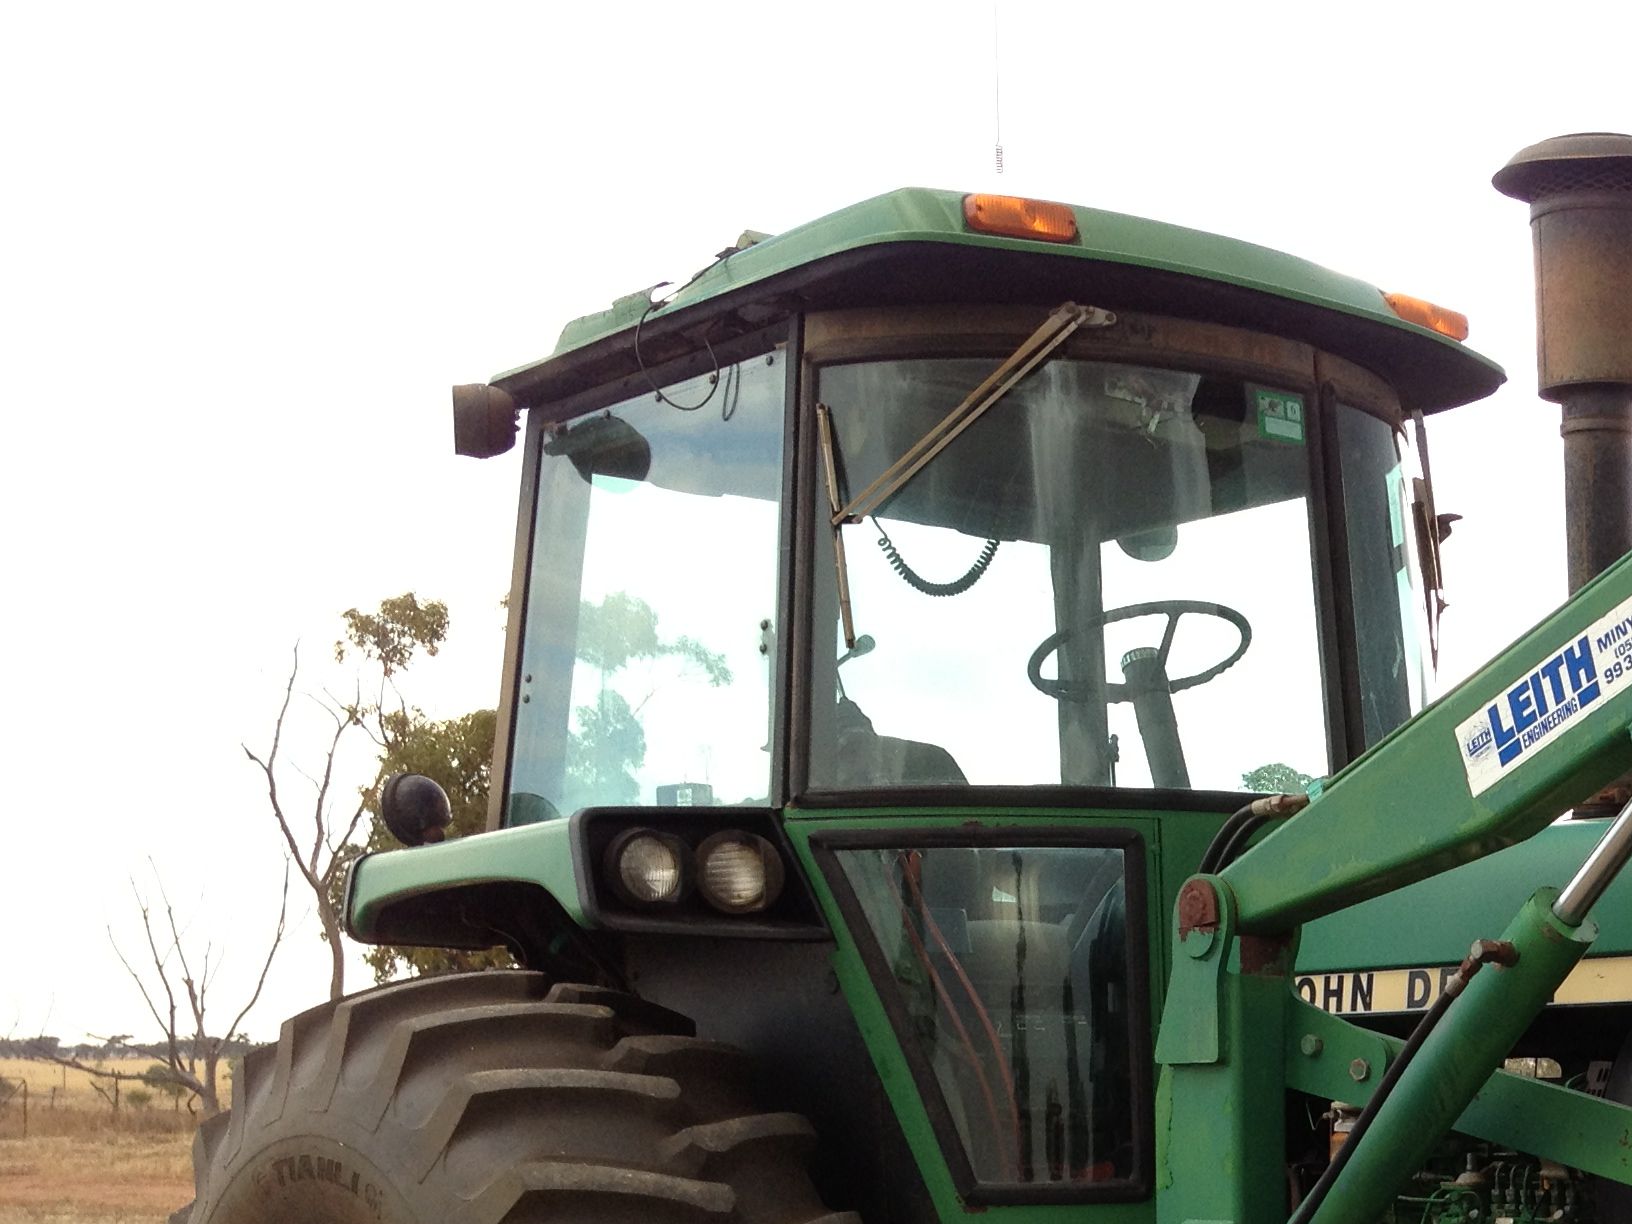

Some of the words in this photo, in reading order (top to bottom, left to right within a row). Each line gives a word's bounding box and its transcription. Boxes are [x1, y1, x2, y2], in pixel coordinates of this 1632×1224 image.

[1487, 635, 1598, 750] LEITH
[1466, 727, 1492, 752] LEITH
[1521, 697, 1579, 749] ENGINEERING
